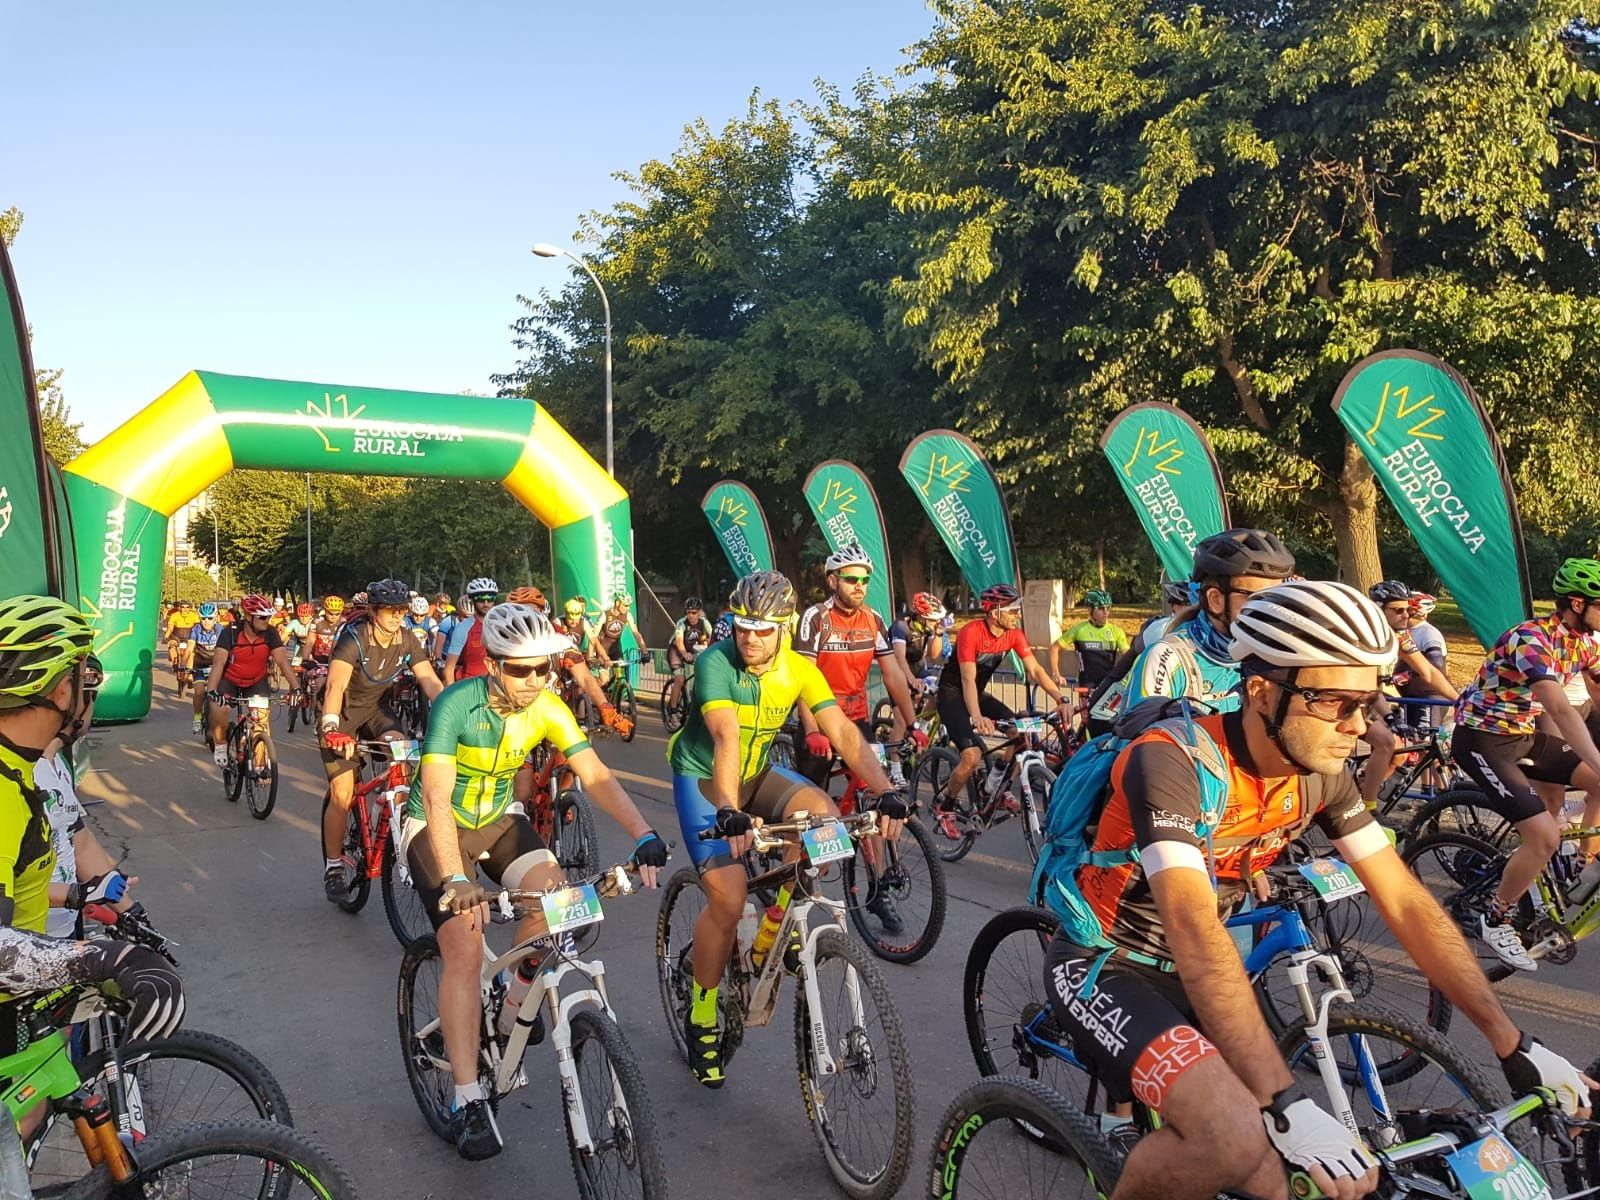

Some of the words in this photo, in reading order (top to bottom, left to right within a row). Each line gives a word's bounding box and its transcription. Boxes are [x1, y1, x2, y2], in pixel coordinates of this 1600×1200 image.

[353, 437, 425, 456] RURAL
[1135, 480, 1175, 542] RURAL
[1382, 450, 1439, 527] RURAL
[1402, 439, 1486, 554] EUROCAJA
[826, 517, 849, 550] RURA
[933, 498, 969, 550] RURAL
[945, 491, 996, 568] EUROCAJA
[1150, 472, 1197, 557] EUROCAJ
[722, 530, 745, 568] RURAL
[118, 544, 140, 611] RURAL
[1470, 751, 1515, 798] FOX
[817, 838, 844, 856] 2231
[1153, 819, 1178, 829] MEN
[1323, 871, 1352, 891] 2161
[558, 901, 591, 922] 2251
[1052, 964, 1074, 1006] MEN
[1069, 1000, 1126, 1058] EXPERT
